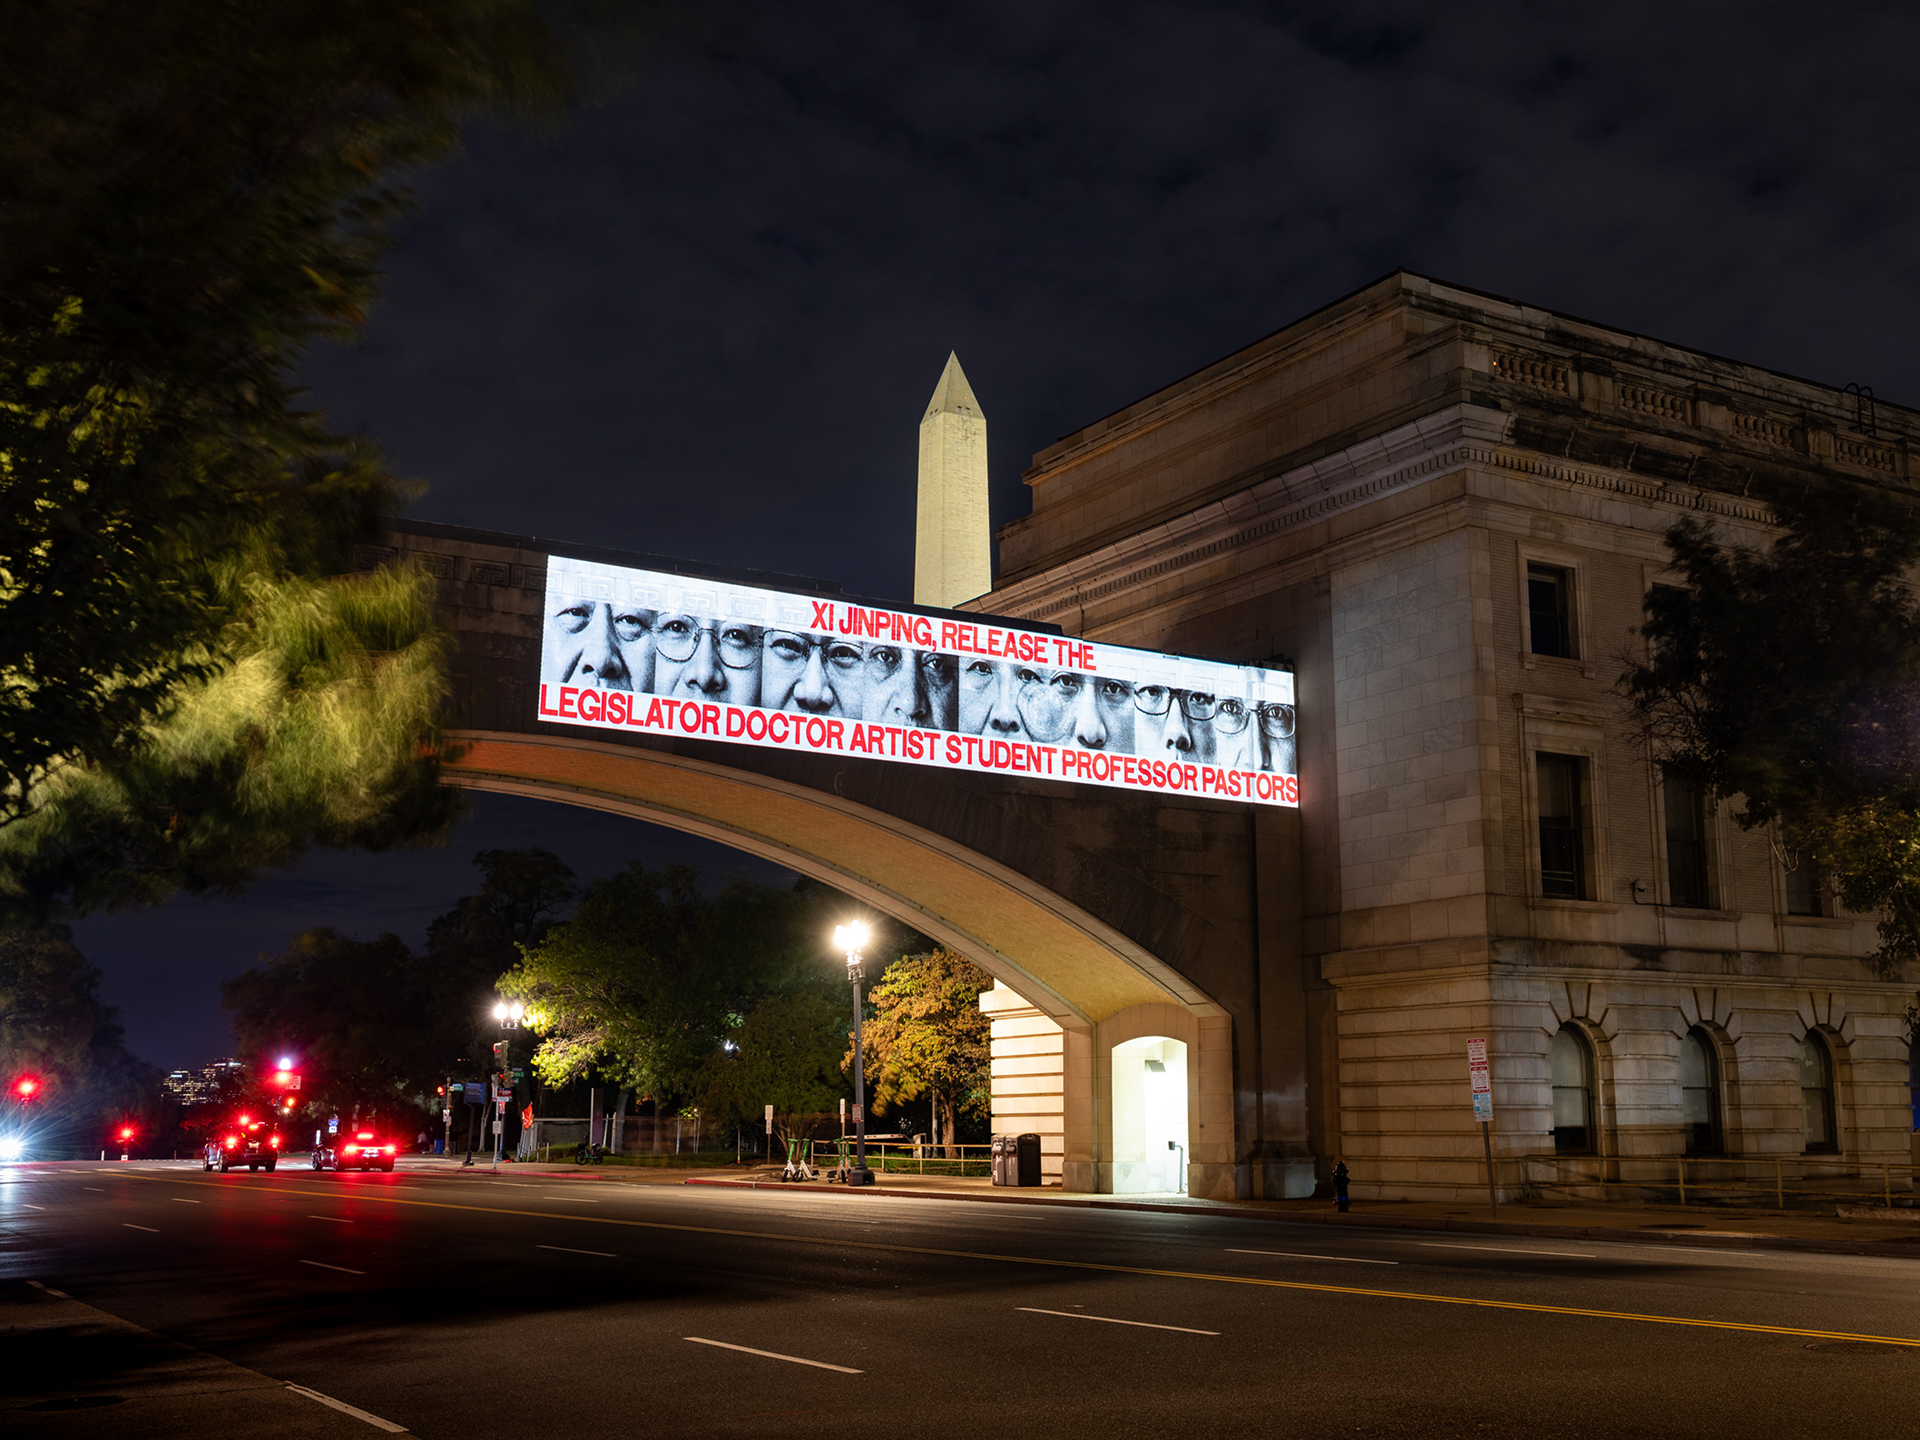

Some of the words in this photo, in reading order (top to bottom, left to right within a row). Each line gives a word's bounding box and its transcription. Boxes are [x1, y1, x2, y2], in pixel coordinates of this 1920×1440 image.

[810, 601, 834, 632] XI
[839, 606, 938, 653] JINPING,
[942, 621, 1049, 664] RELEASE
[1053, 638, 1097, 672] THE
[540, 683, 720, 736] LEGISLATOR
[726, 706, 844, 750] DOCTOR
[850, 723, 941, 761] ARTIST
[946, 734, 1057, 775] STUDENT
[1062, 749, 1197, 792] PROFESSOR
[1202, 766, 1298, 804] PASTORS
